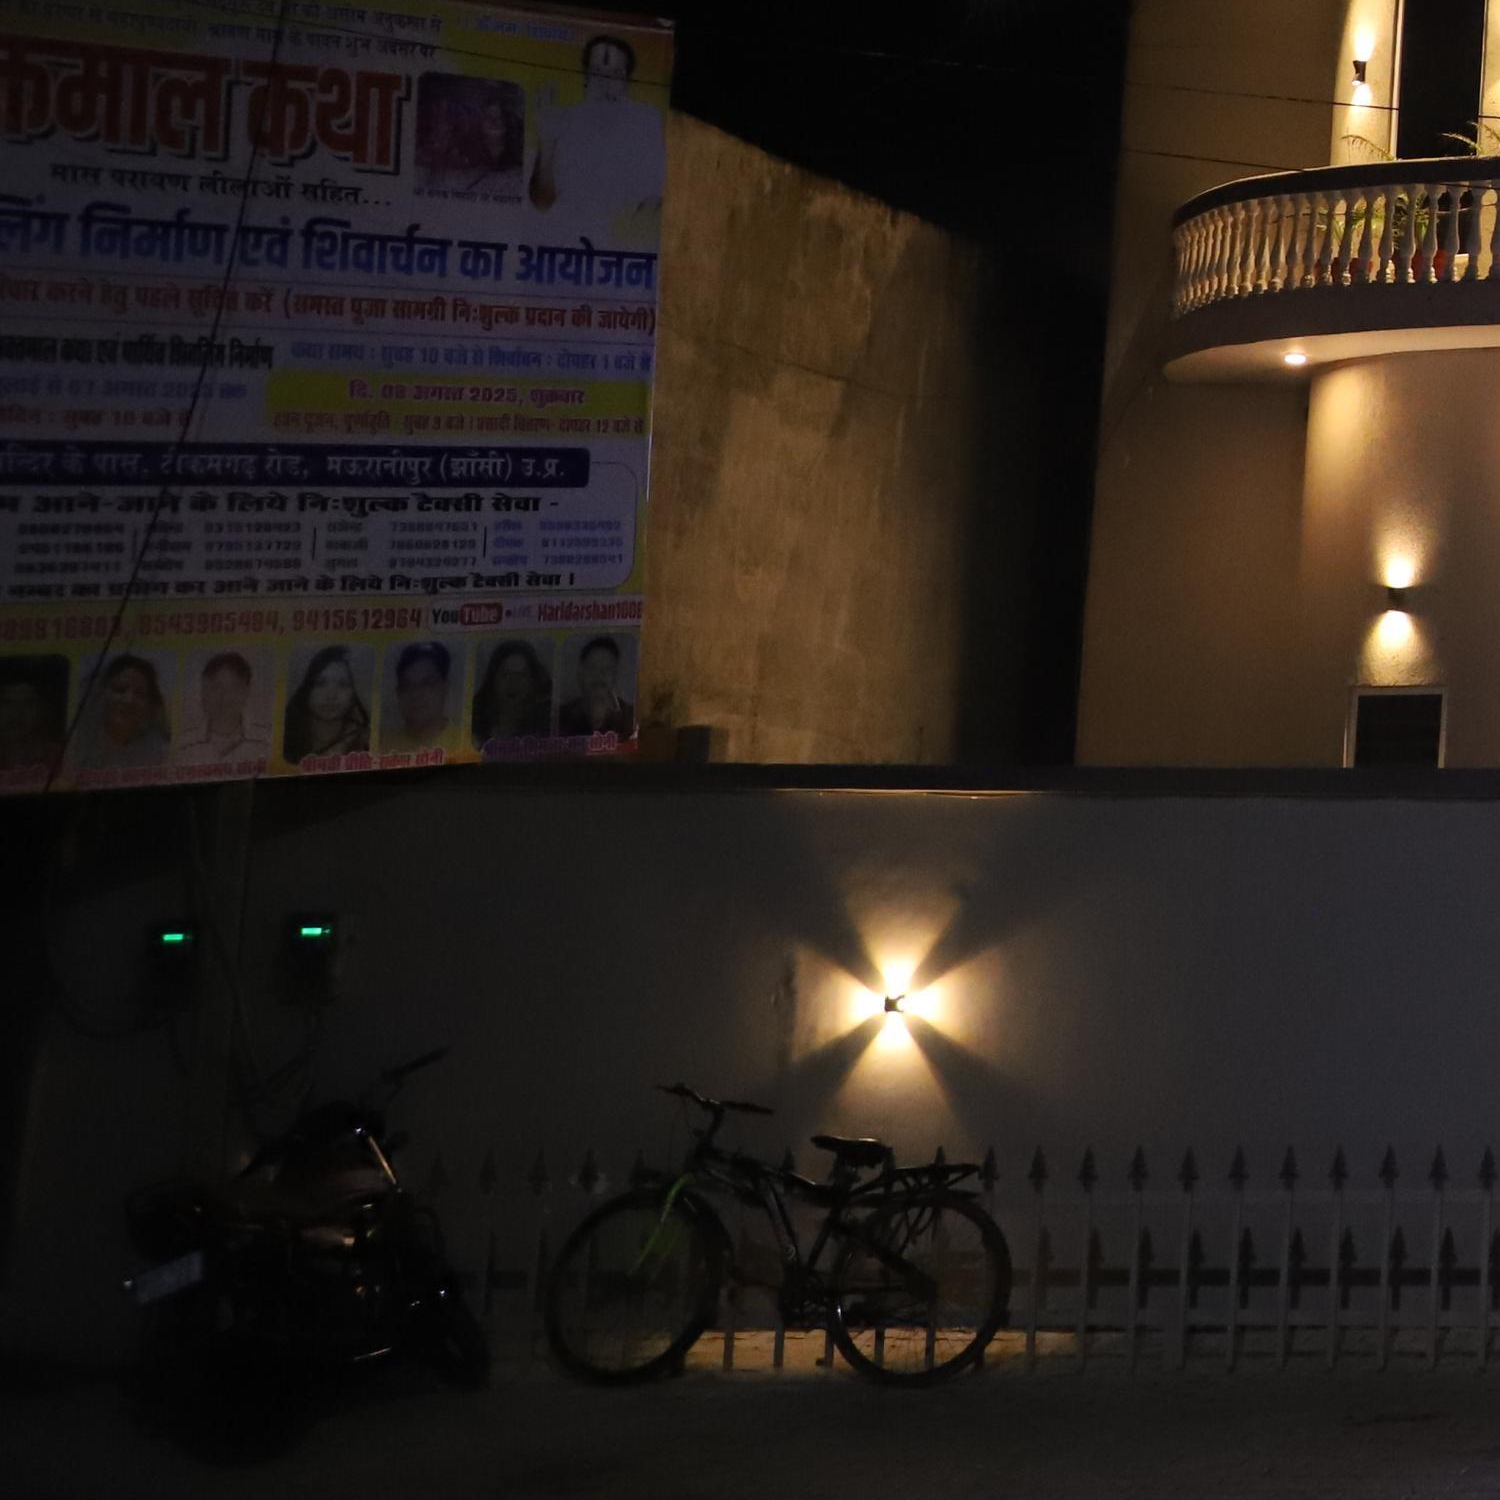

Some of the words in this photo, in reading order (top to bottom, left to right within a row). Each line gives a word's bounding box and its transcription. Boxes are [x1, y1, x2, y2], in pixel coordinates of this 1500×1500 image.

[246, 60, 411, 175] कथा
[78, 200, 229, 265] निर्माण
[238, 215, 294, 267] एवं
[300, 216, 452, 278] शिवार्चन
[458, 240, 508, 281] का
[516, 236, 657, 288] आयोजन
[351, 299, 386, 324] पूजा
[526, 305, 566, 328] प्रदान
[572, 303, 592, 329] की
[492, 492, 542, 512] सेवा
